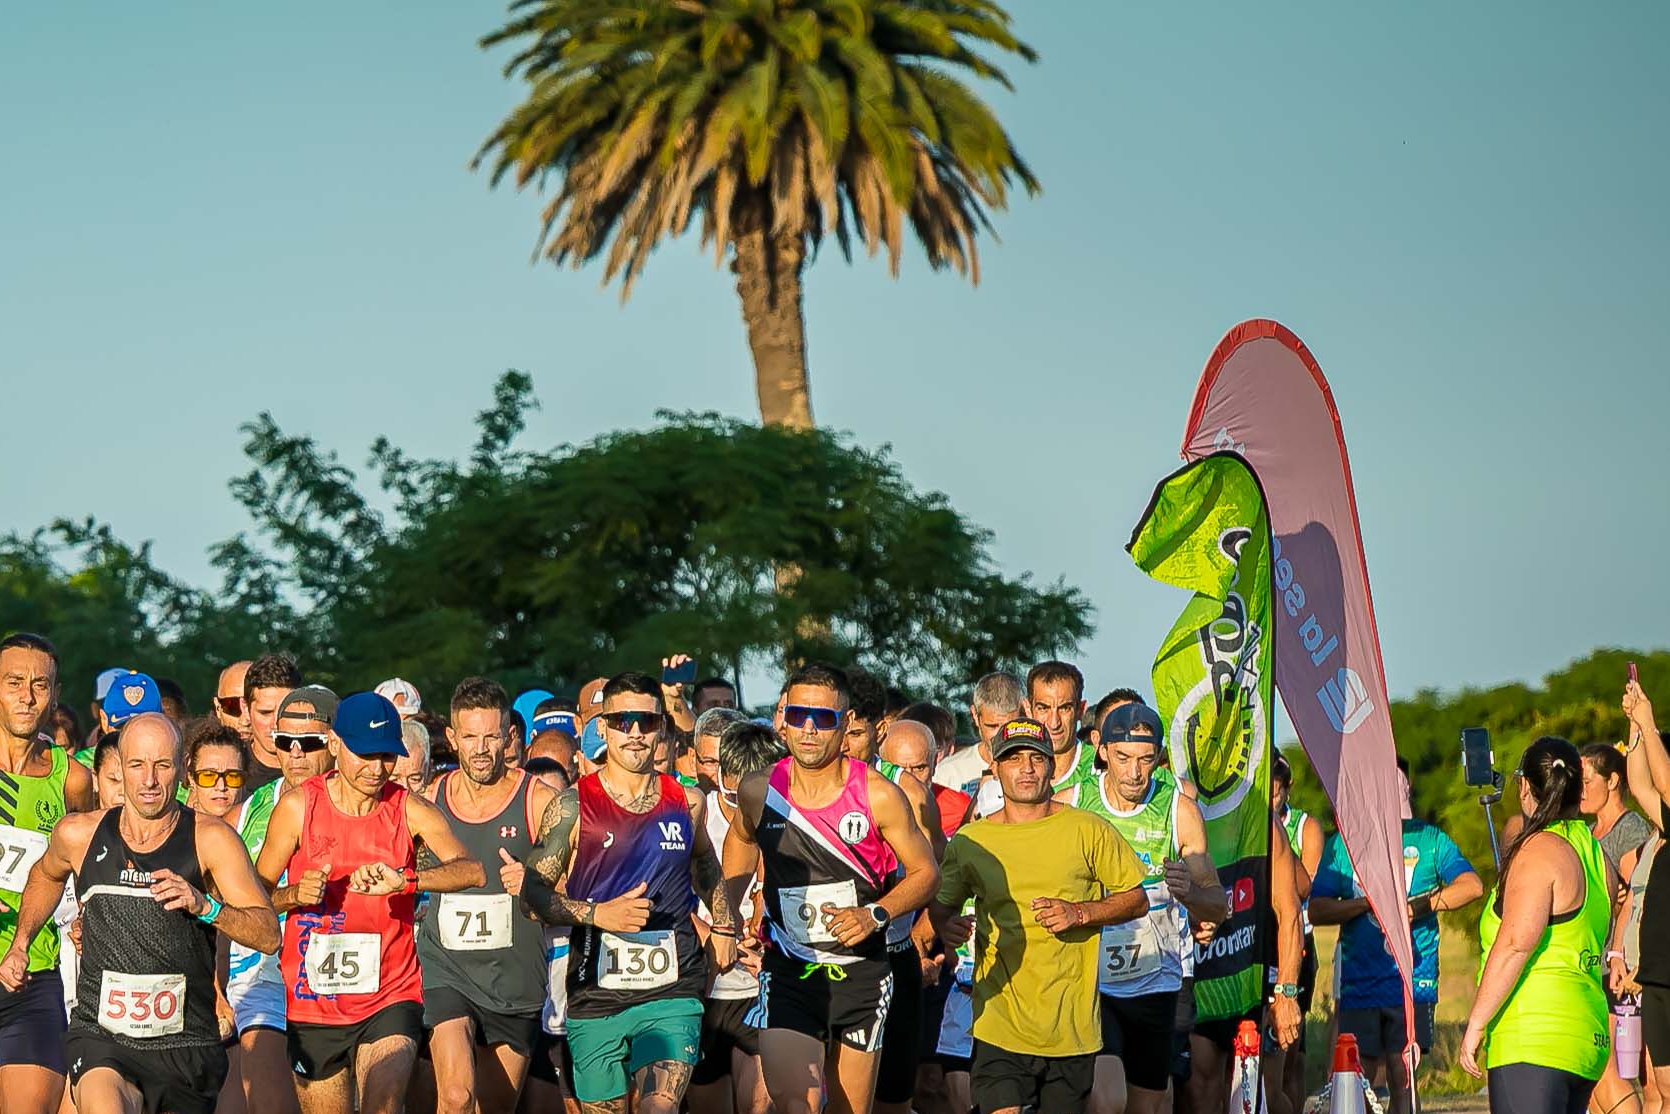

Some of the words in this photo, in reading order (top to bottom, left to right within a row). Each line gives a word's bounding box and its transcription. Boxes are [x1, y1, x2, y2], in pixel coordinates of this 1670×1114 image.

[658, 822, 684, 842] VR
[659, 842, 686, 851] TEAM
[456, 911, 492, 937] 71
[317, 951, 360, 980] 45
[606, 947, 670, 975] 130
[1105, 943, 1142, 971] 37
[106, 990, 178, 1021] 530
